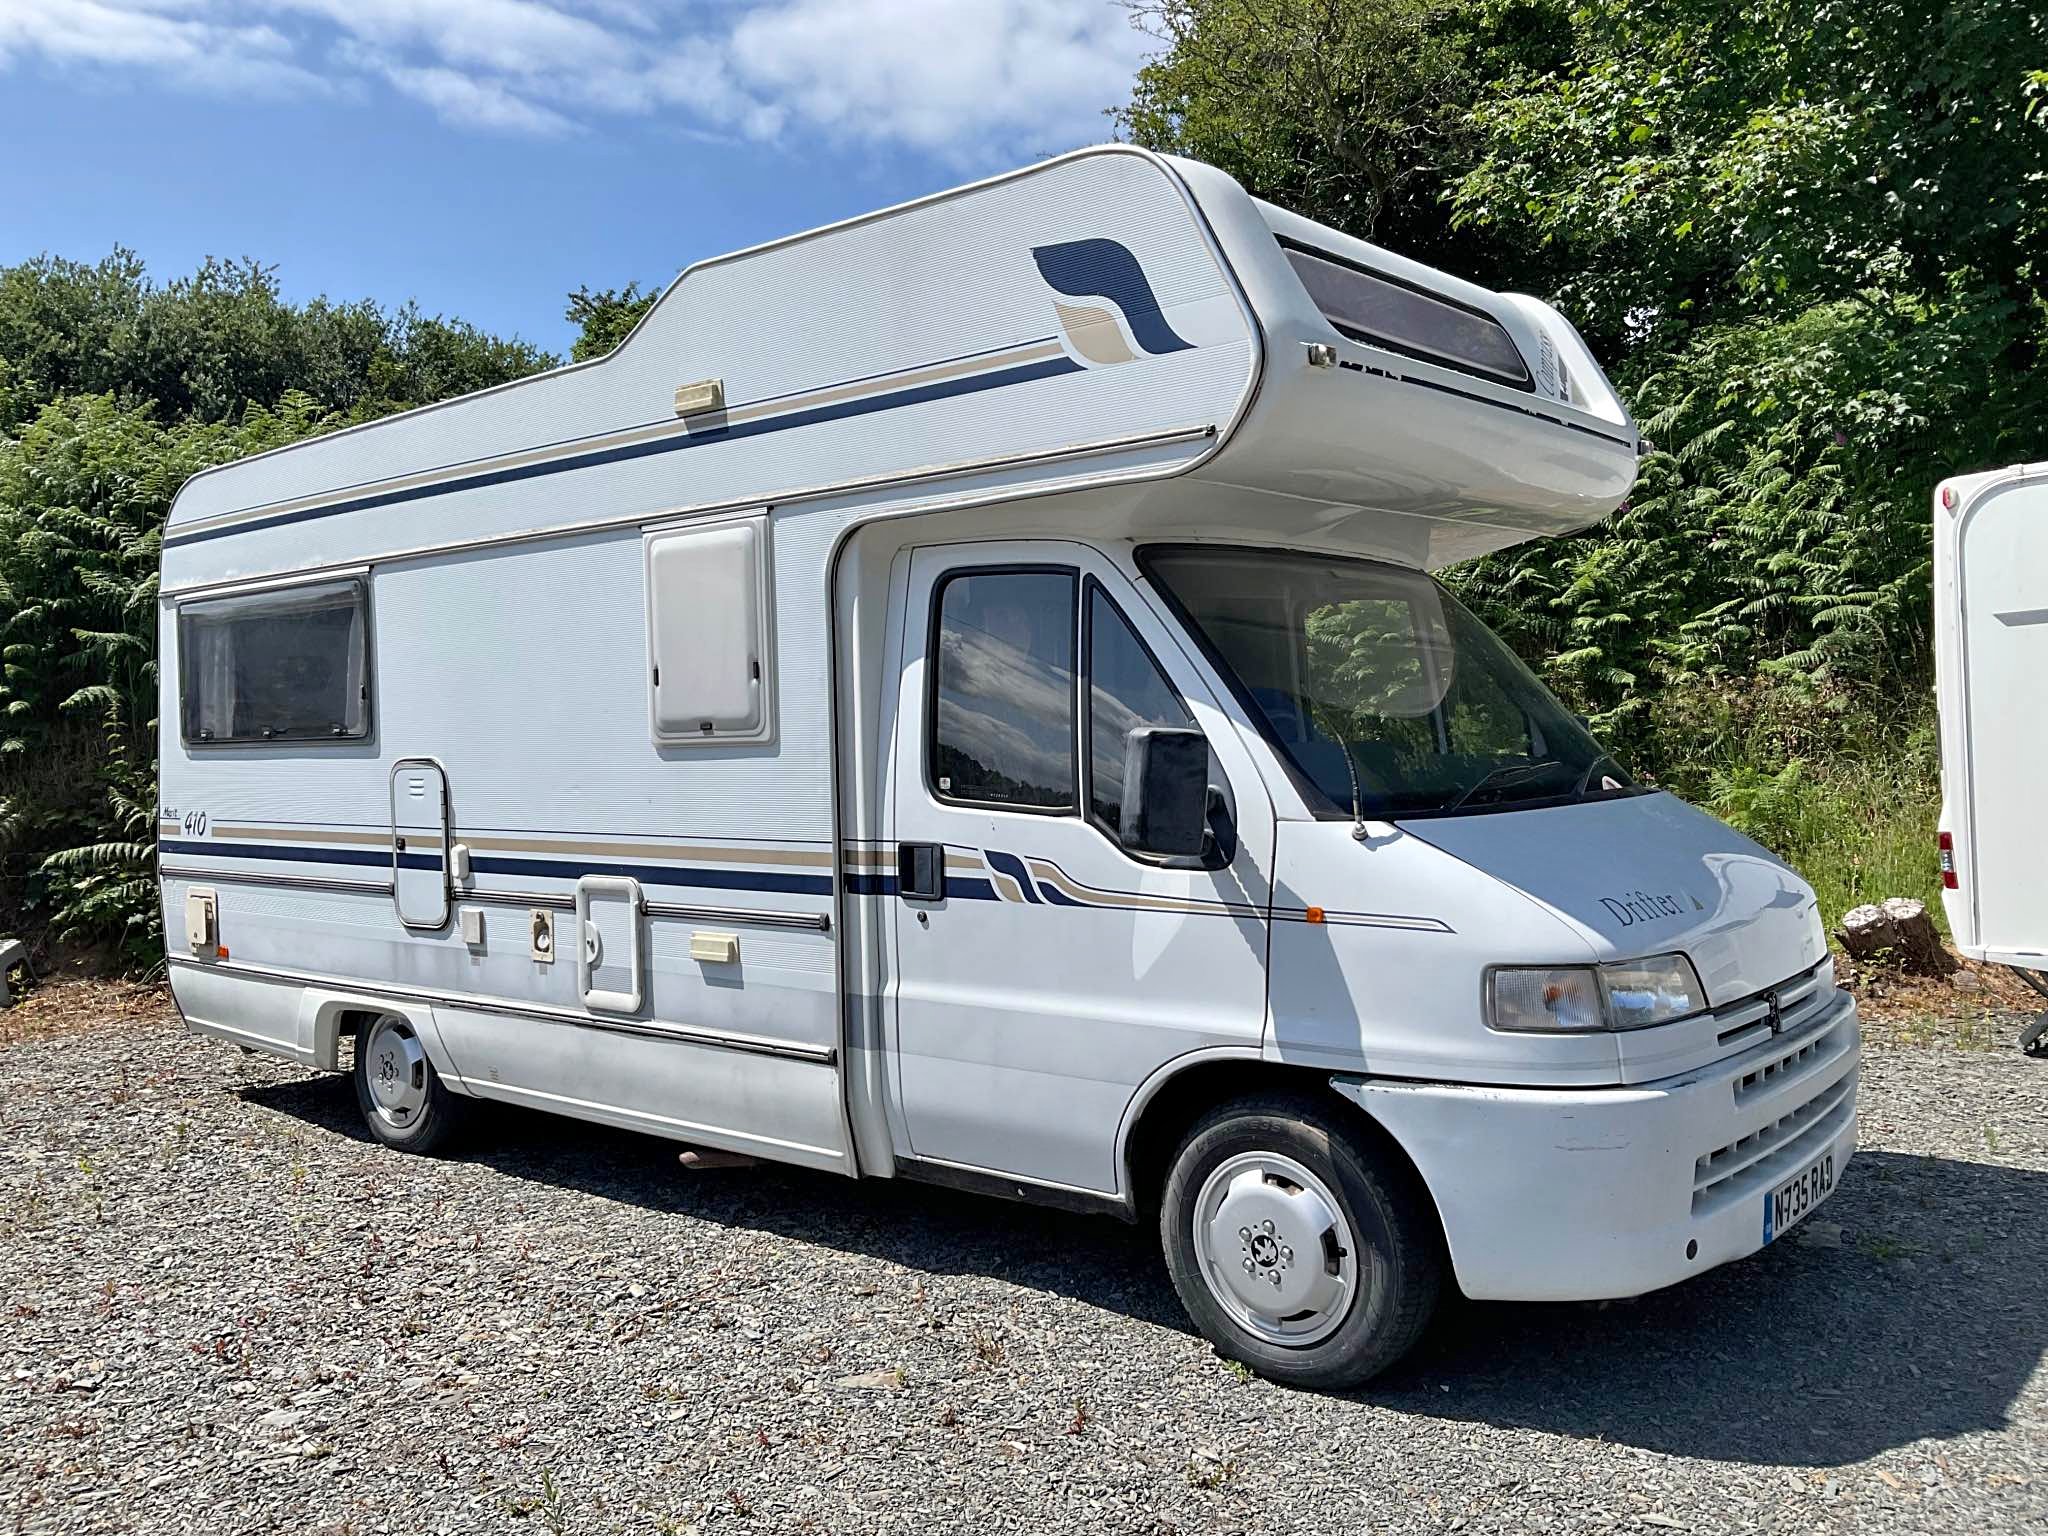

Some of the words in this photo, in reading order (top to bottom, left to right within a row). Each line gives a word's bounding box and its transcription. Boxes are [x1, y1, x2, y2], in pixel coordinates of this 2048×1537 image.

[184, 811, 207, 836] 410
[1599, 890, 1684, 927] Drifter
[1775, 1174, 1808, 1231] N735
[1811, 1155, 1833, 1203] RAD
